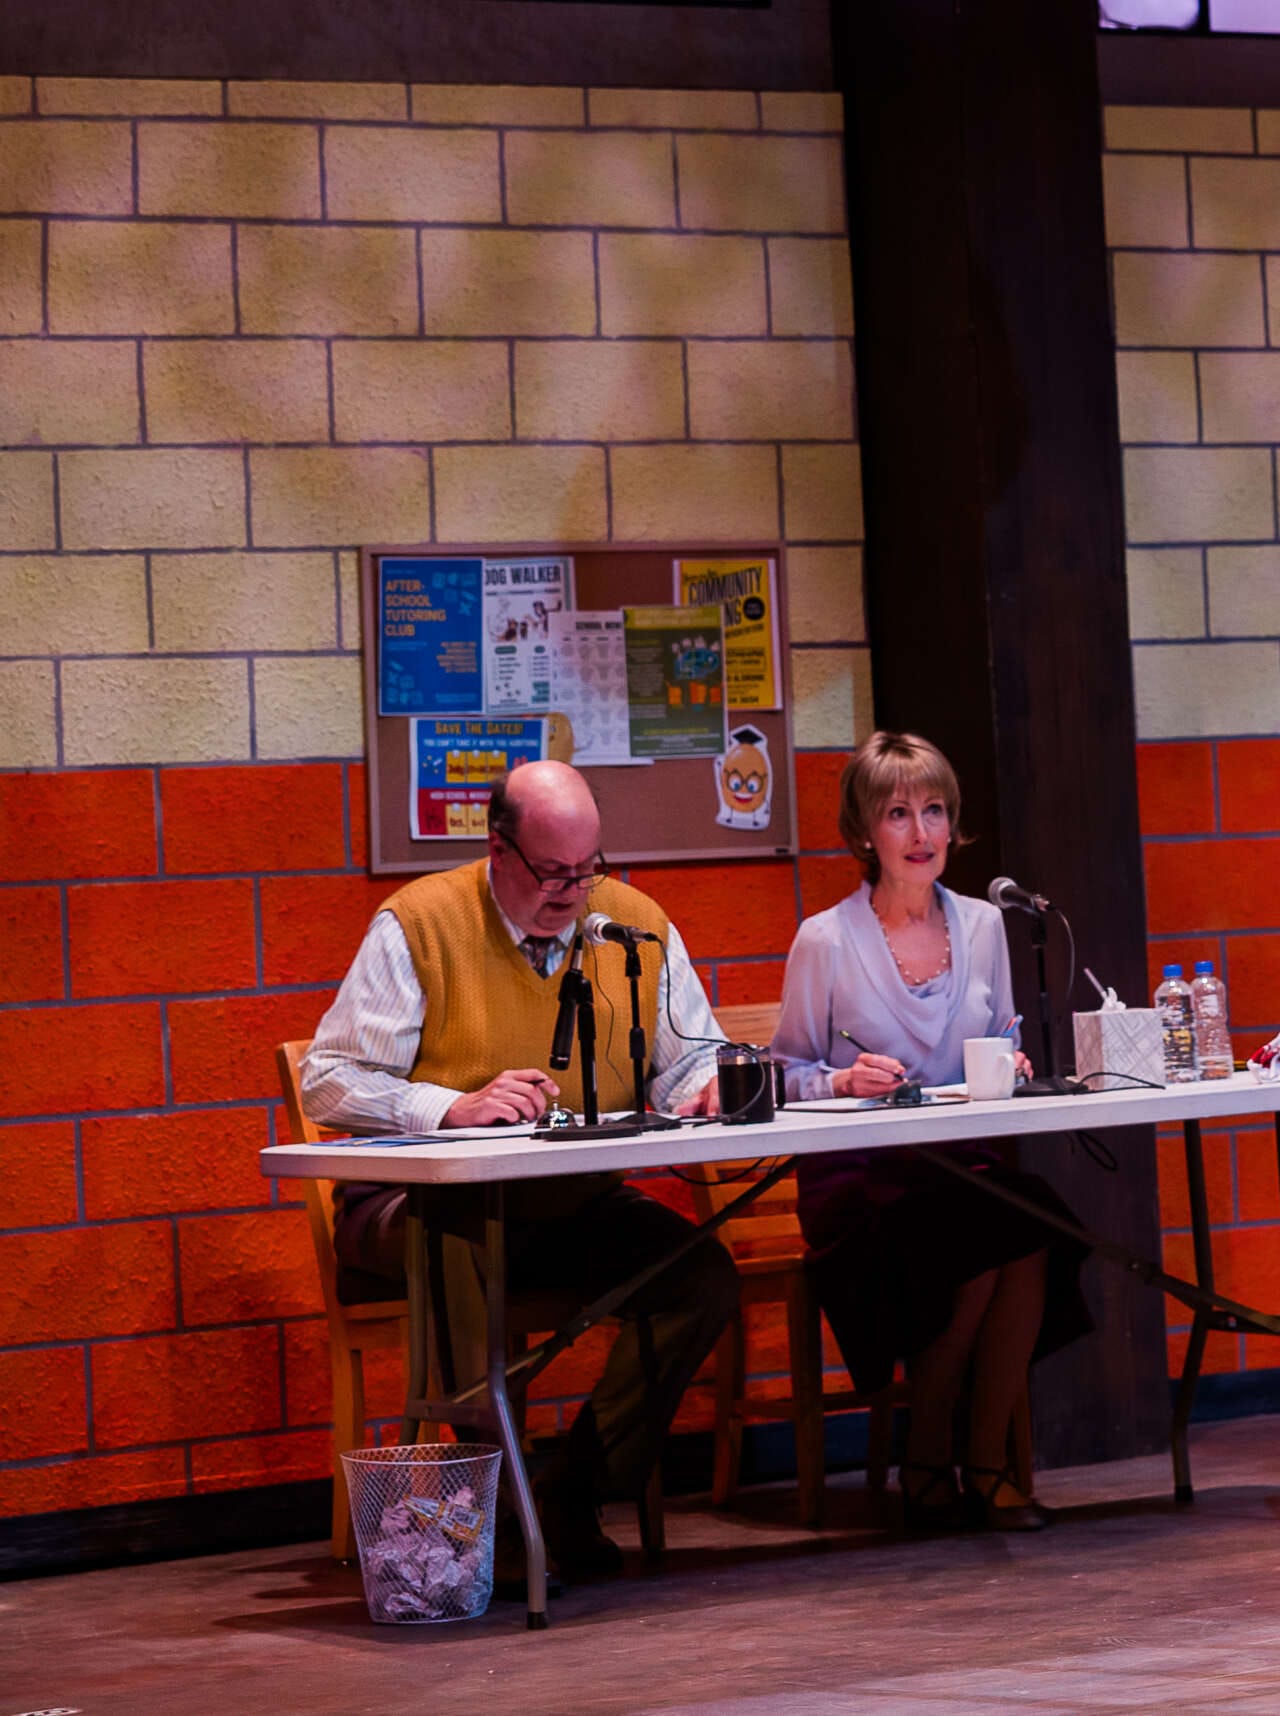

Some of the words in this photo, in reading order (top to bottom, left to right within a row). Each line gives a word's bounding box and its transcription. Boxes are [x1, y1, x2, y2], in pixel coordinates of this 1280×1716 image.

[510, 565, 561, 584] WALKER
[385, 579, 425, 592] AFTER-
[688, 565, 763, 606] COMMUNITY
[385, 594, 432, 607] SCHOOL
[385, 608, 447, 621] TUTORING
[385, 623, 416, 636] CLUB
[435, 721, 461, 735] SAVE
[465, 721, 482, 735] THE
